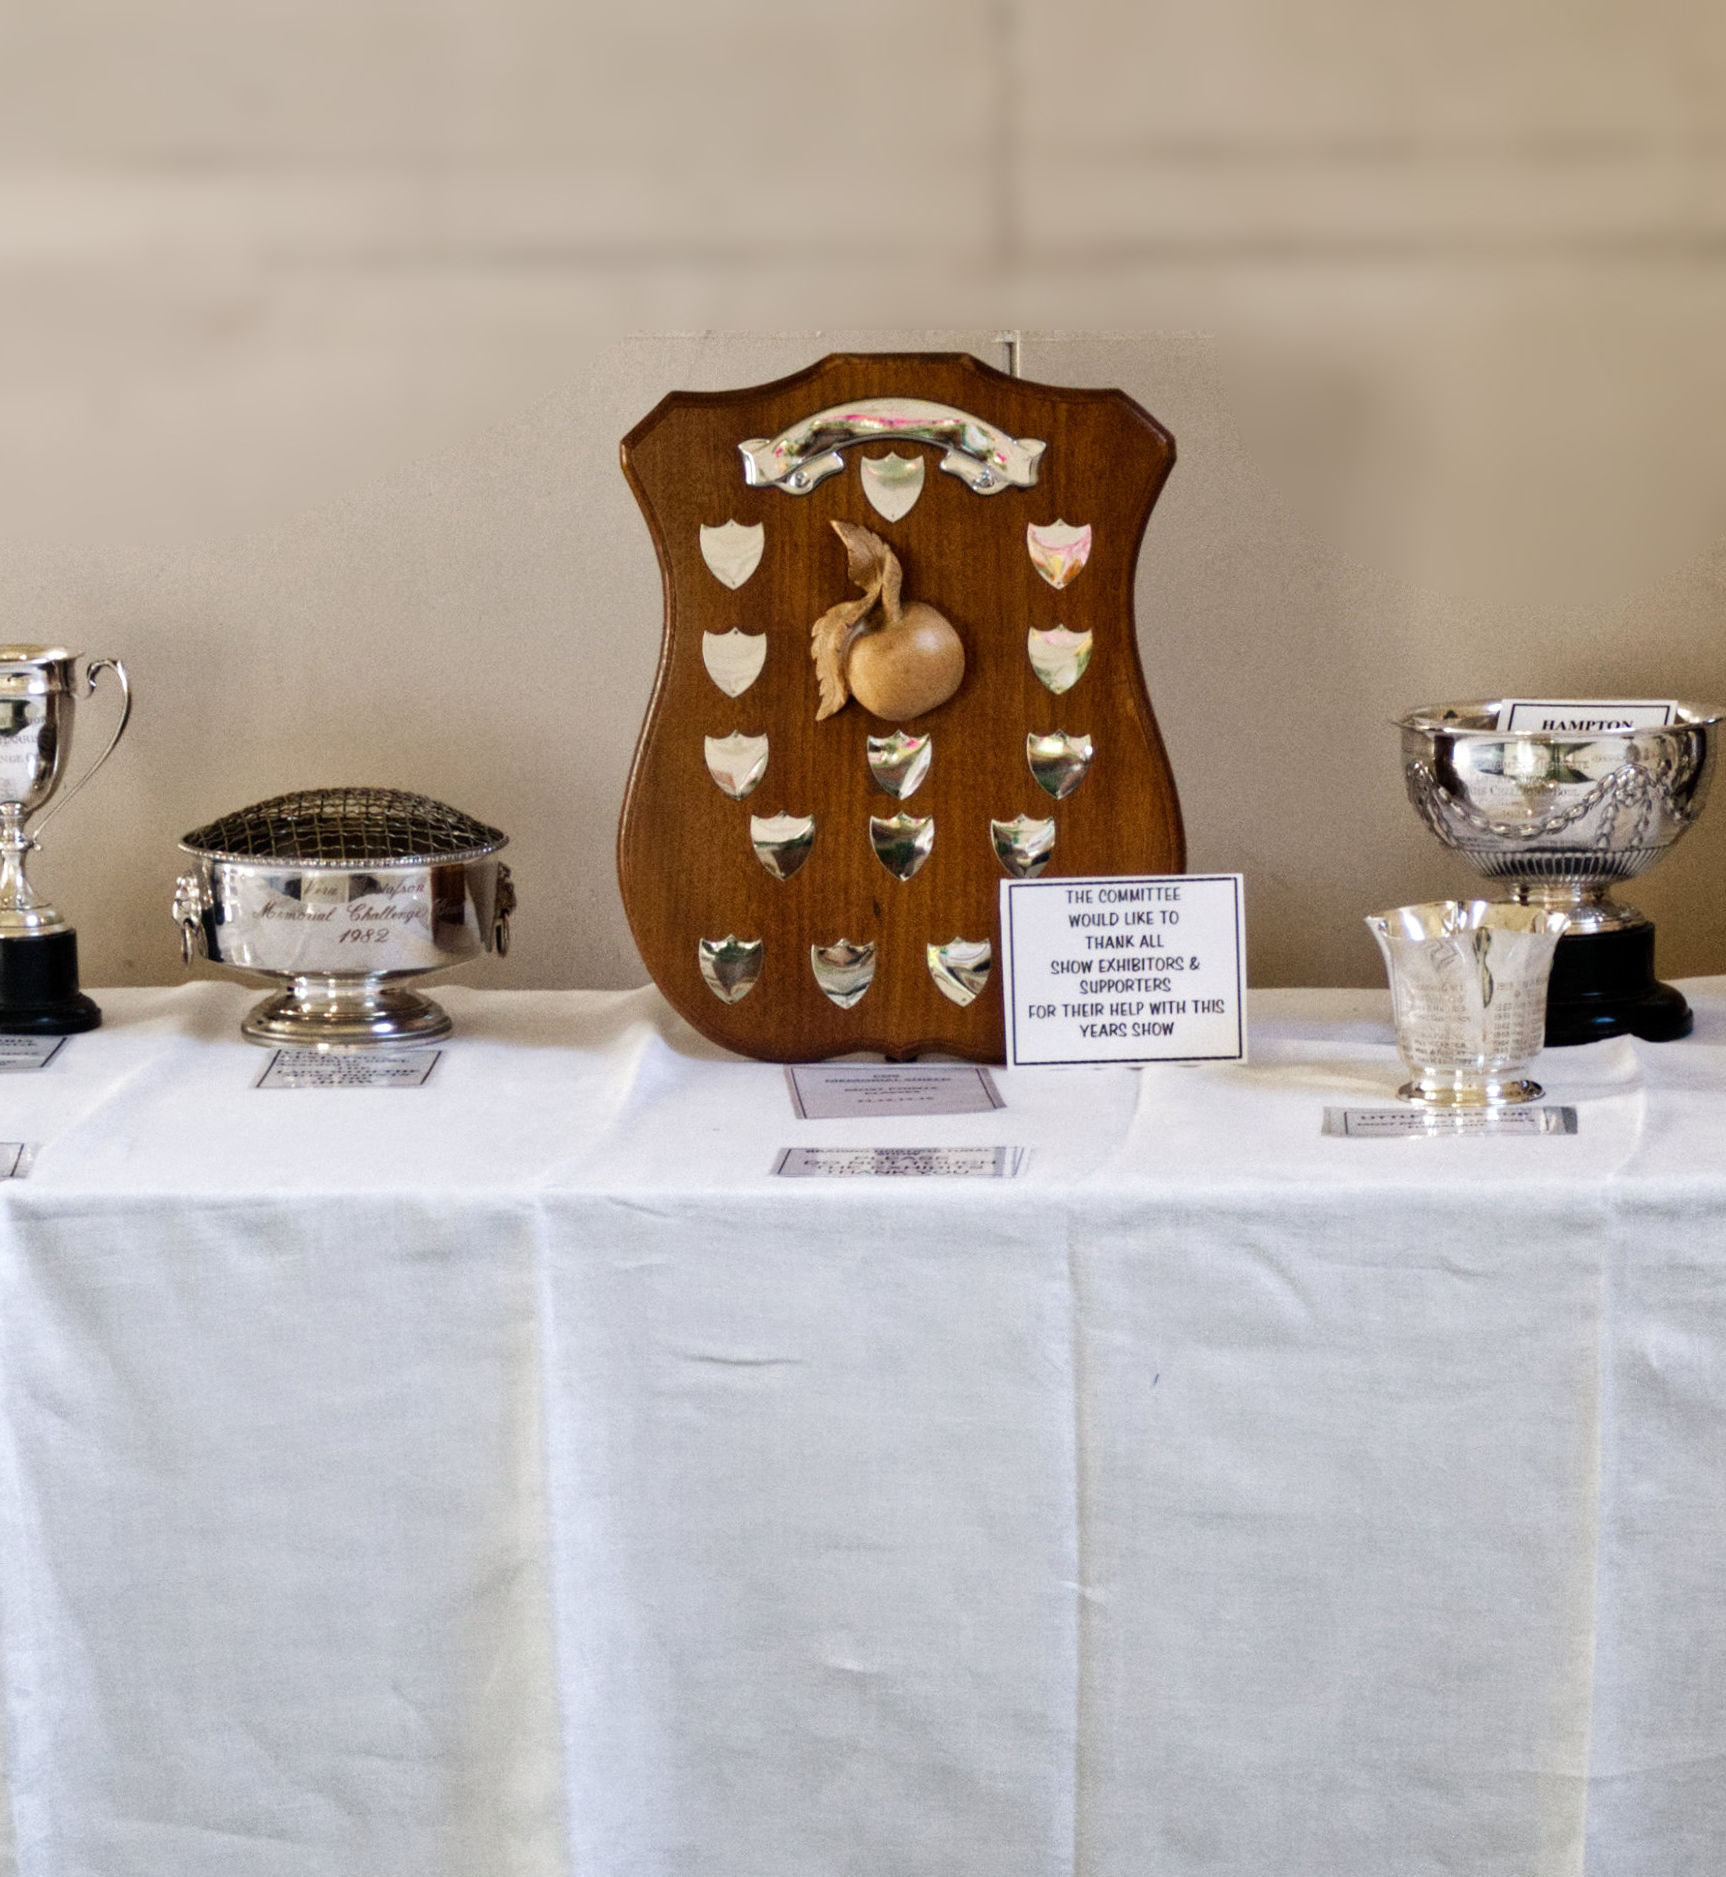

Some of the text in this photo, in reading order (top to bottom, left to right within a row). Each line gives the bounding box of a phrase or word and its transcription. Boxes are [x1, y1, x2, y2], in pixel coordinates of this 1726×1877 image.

[1541, 719, 1634, 731] HAMPTON
[1065, 887, 1181, 904] THE COMMITTEE
[252, 900, 338, 922] Memorial
[345, 901, 427, 923] Challenge
[1068, 910, 1180, 928] WOULD LIKE TO
[338, 928, 392, 944] 1982
[1085, 934, 1164, 950] THANK ALL
[1050, 956, 1200, 975] SHOW EXHIBITORS &
[1079, 977, 1171, 995] SUPPORTERS
[1028, 999, 1225, 1019] FOR THEIR HELP WITH THIS
[1079, 1022, 1175, 1038] YEARS SHOW
